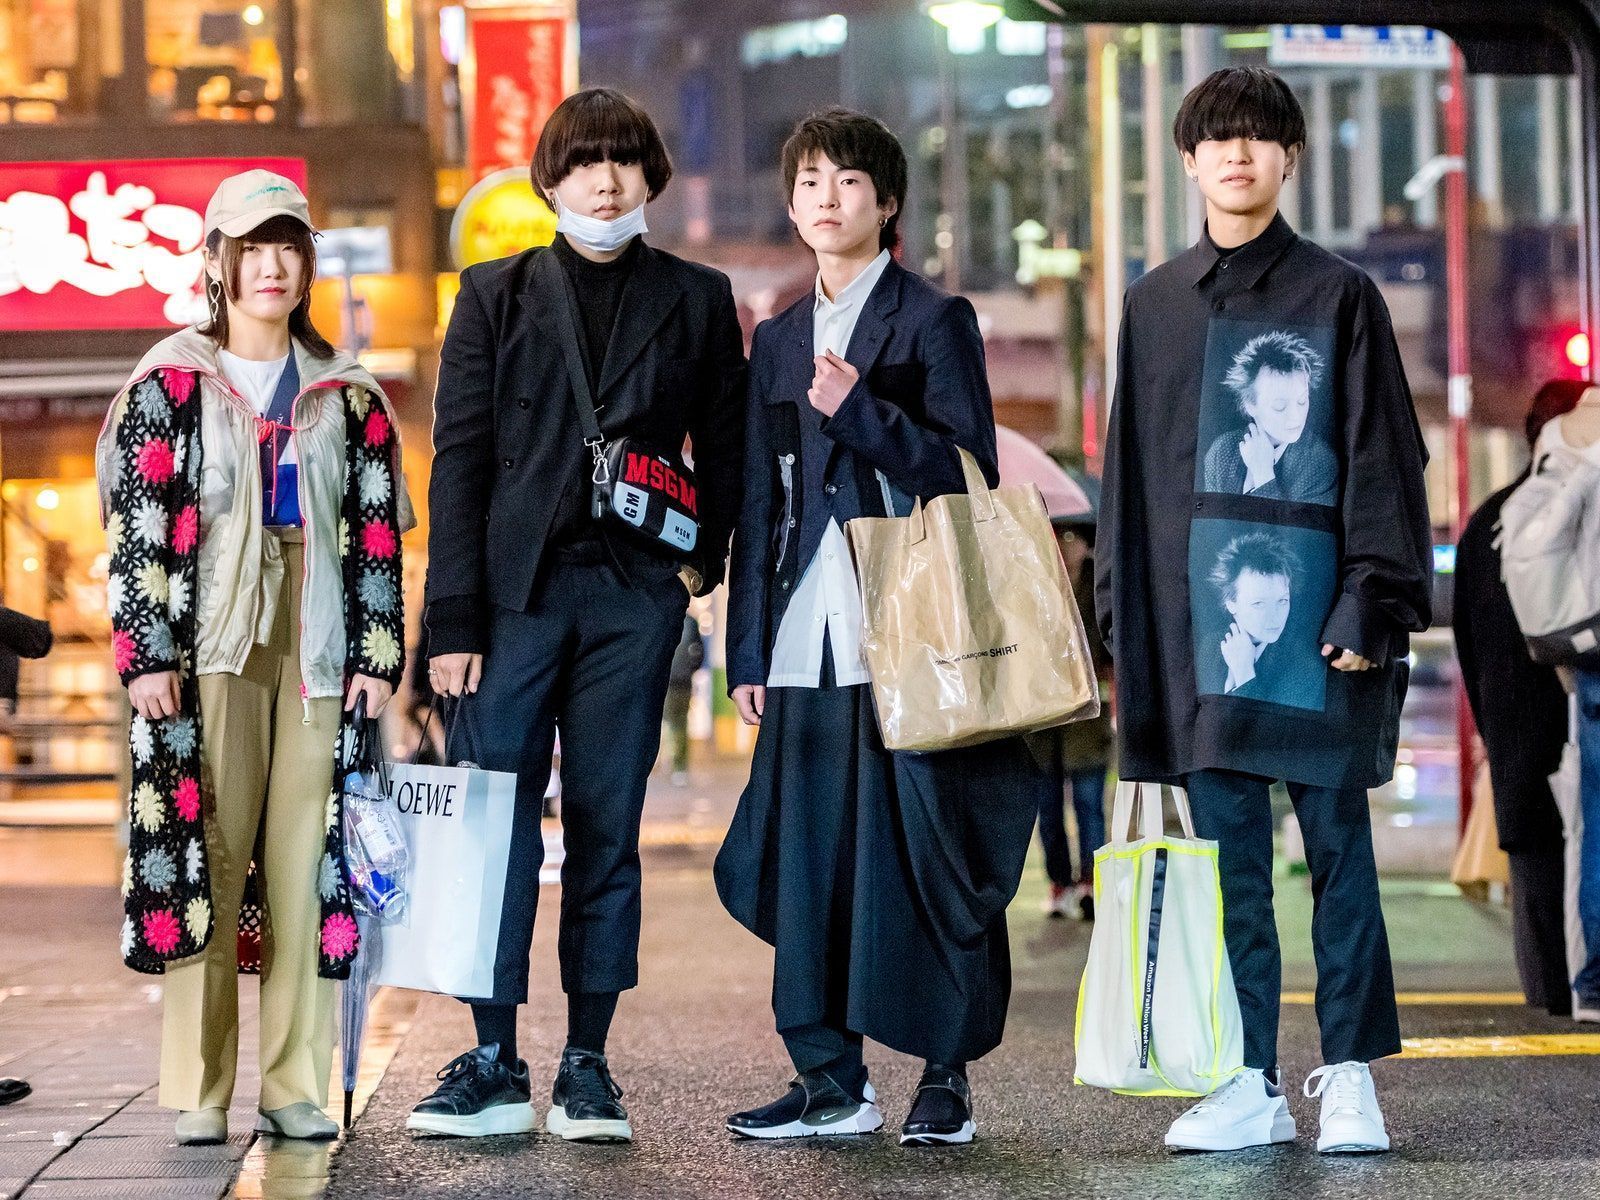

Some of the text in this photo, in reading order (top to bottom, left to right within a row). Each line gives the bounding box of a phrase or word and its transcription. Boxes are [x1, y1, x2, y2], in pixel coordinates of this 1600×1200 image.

[625, 453, 698, 516] MSGM
[623, 491, 640, 519] GM
[989, 643, 1018, 658] SHIRT
[1146, 961, 1155, 993] Amazon
[1143, 993, 1152, 1024] Fashion
[1142, 1023, 1150, 1044] Week
